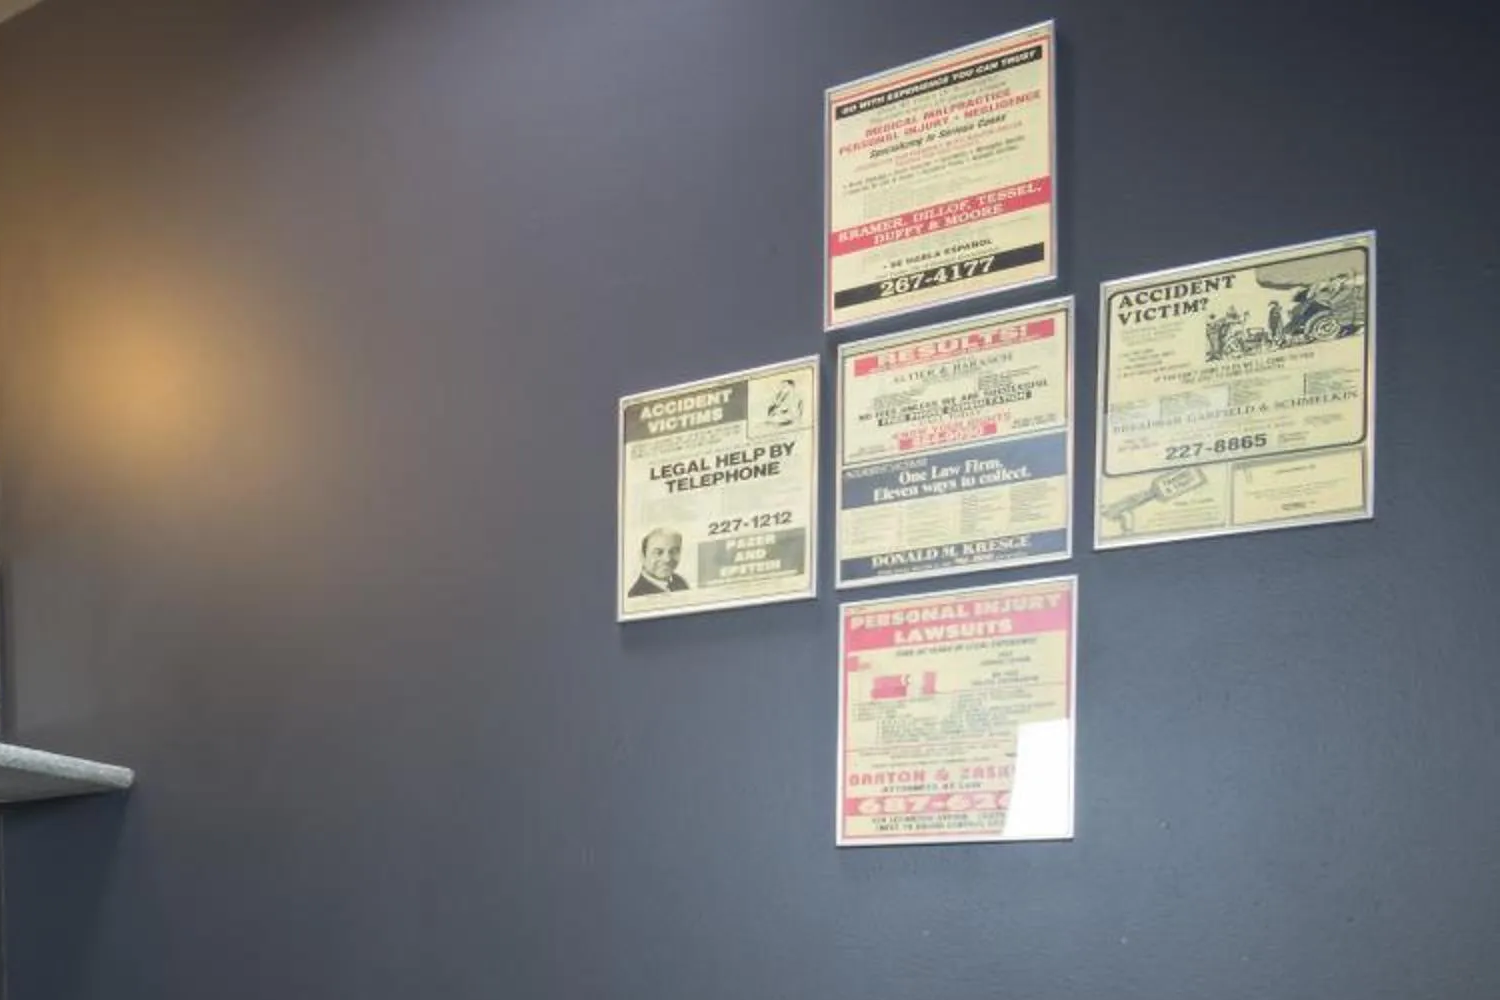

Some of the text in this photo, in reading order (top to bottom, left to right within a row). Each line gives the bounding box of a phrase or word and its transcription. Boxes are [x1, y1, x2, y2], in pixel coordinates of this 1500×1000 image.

[879, 255, 994, 298] 267-4177
[1118, 274, 1236, 309] ACCIDENT
[1118, 297, 1208, 326] VICTIM?
[640, 388, 732, 419] ACCIDENT
[647, 407, 723, 434] VICTIMS
[650, 441, 794, 481] LEGAL HELP BY
[1165, 432, 1267, 460] 227-8865
[666, 461, 780, 493] TELEPHONE
[707, 509, 792, 536] 227-1212
[872, 546, 939, 567] DONALD
[850, 593, 1061, 629] PERSONAL INJURY
[893, 618, 1012, 643] LAWSUITS
